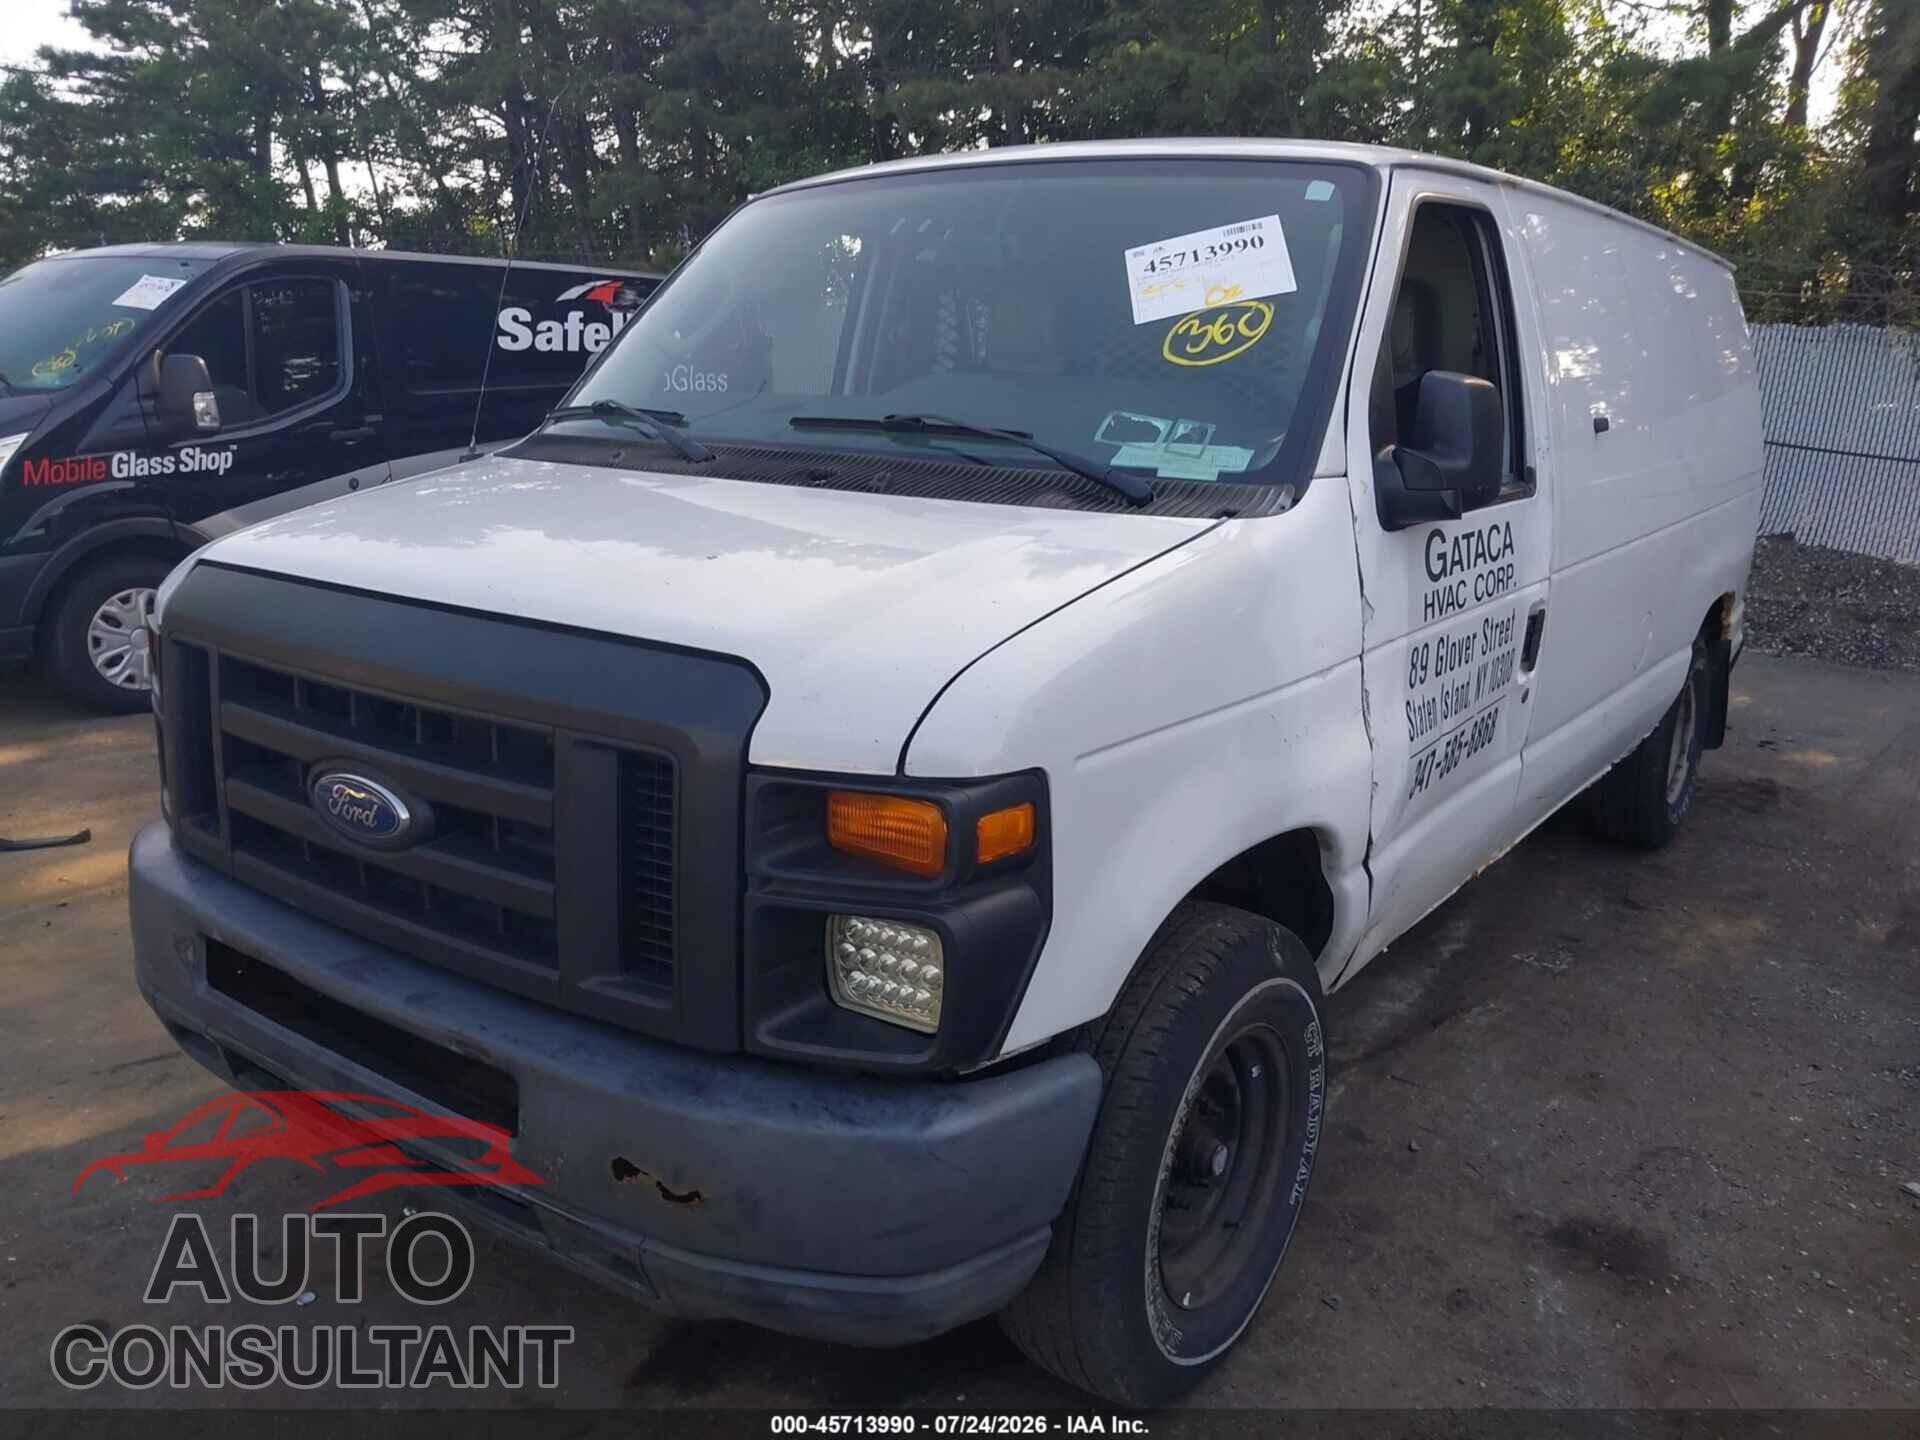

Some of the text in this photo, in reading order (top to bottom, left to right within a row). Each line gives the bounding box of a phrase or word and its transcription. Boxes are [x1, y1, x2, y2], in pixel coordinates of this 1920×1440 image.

[1144, 235, 1265, 273] 45713990
[497, 307, 633, 352] Safel
[1177, 309, 1271, 353] 360
[23, 455, 106, 486] Mobile
[111, 451, 175, 479] Glass
[1424, 521, 1515, 583] GATACA
[1424, 563, 1517, 622] HVAC CORP.
[1409, 607, 1516, 689] 89 Glover Street
[1405, 699, 1438, 742] Staten
[328, 784, 382, 828] Ford
